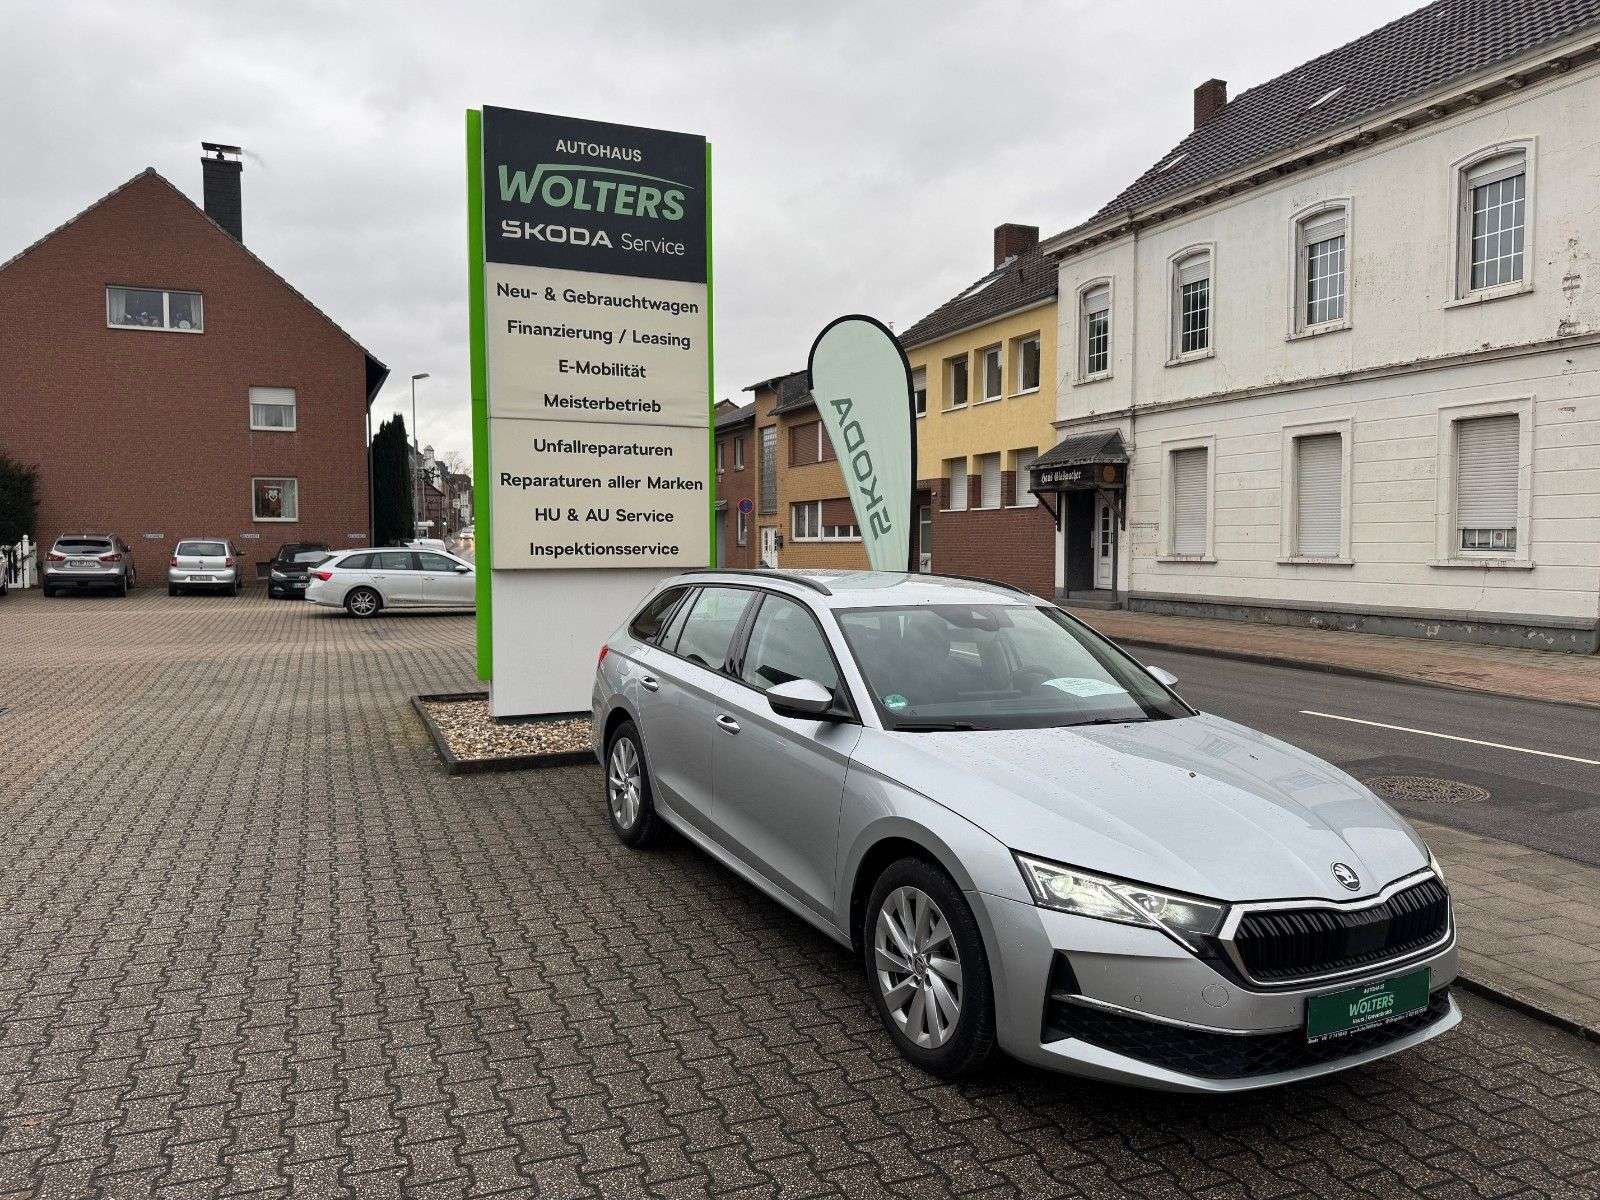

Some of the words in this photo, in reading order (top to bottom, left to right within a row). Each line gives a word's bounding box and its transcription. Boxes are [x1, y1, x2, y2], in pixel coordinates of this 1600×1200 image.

[556, 139, 642, 162] AUTOHAUS
[497, 163, 687, 221] WOLTERS
[501, 220, 613, 249] SKODA
[621, 233, 685, 256] Service
[497, 282, 537, 299] Neu-
[544, 287, 556, 302] &
[563, 288, 699, 316] Gebrauchtwagen
[507, 320, 613, 345] Finanzierung
[618, 329, 626, 344] /
[632, 329, 691, 351] Leasing
[559, 359, 647, 379] E-Mobilität
[544, 393, 661, 413] Meisterbetrieb
[533, 438, 673, 458] Unfallreparaturen
[830, 397, 892, 541] SKODA
[500, 472, 602, 490] Reparaturen
[607, 475, 641, 489] aller
[647, 476, 703, 491] Marken
[535, 508, 560, 522] HU
[567, 508, 579, 522] &
[586, 508, 610, 522] AU
[616, 508, 674, 523] Service
[530, 542, 679, 559] Inspektionsservice
[1349, 992, 1395, 1017] WOLTERS
